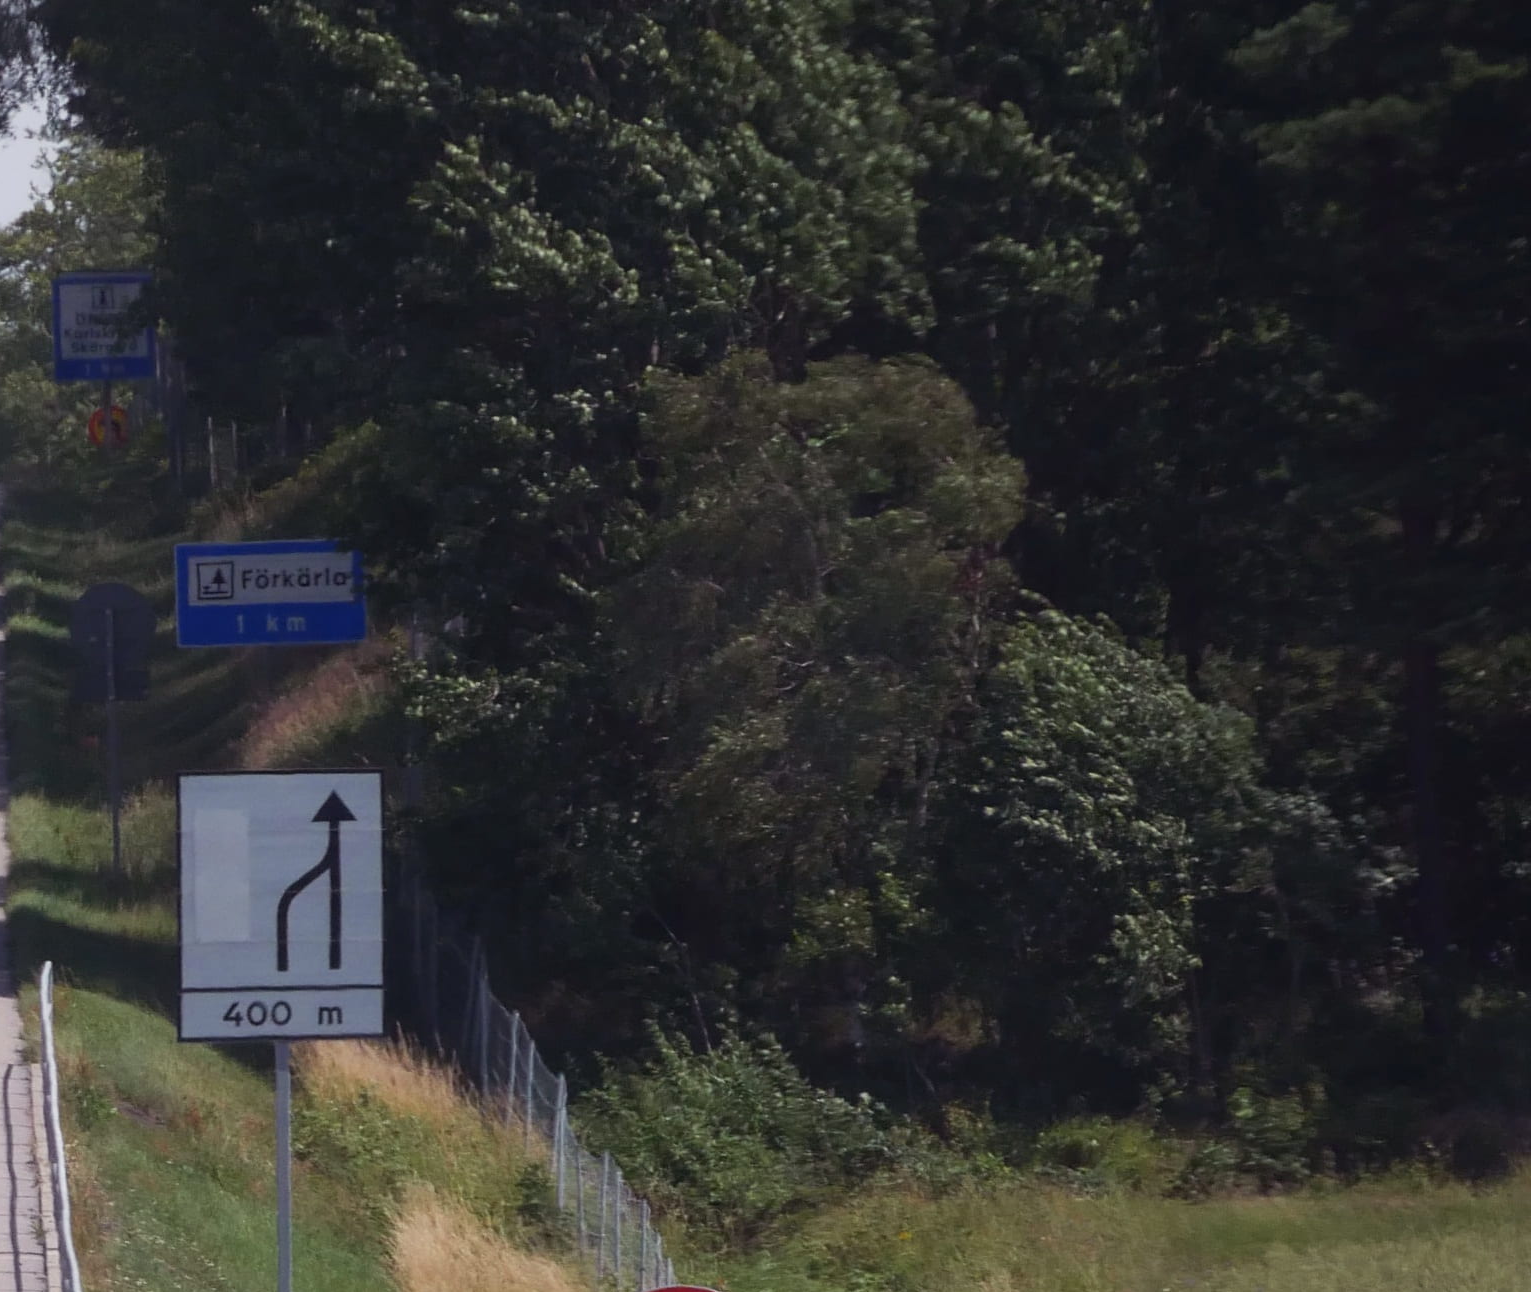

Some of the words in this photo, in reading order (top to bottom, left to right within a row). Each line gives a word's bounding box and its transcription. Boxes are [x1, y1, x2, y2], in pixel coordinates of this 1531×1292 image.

[242, 567, 348, 590] Förkärla
[236, 613, 244, 634] 1
[266, 612, 308, 633] km
[222, 1001, 292, 1027] 400
[318, 1006, 343, 1025] m
